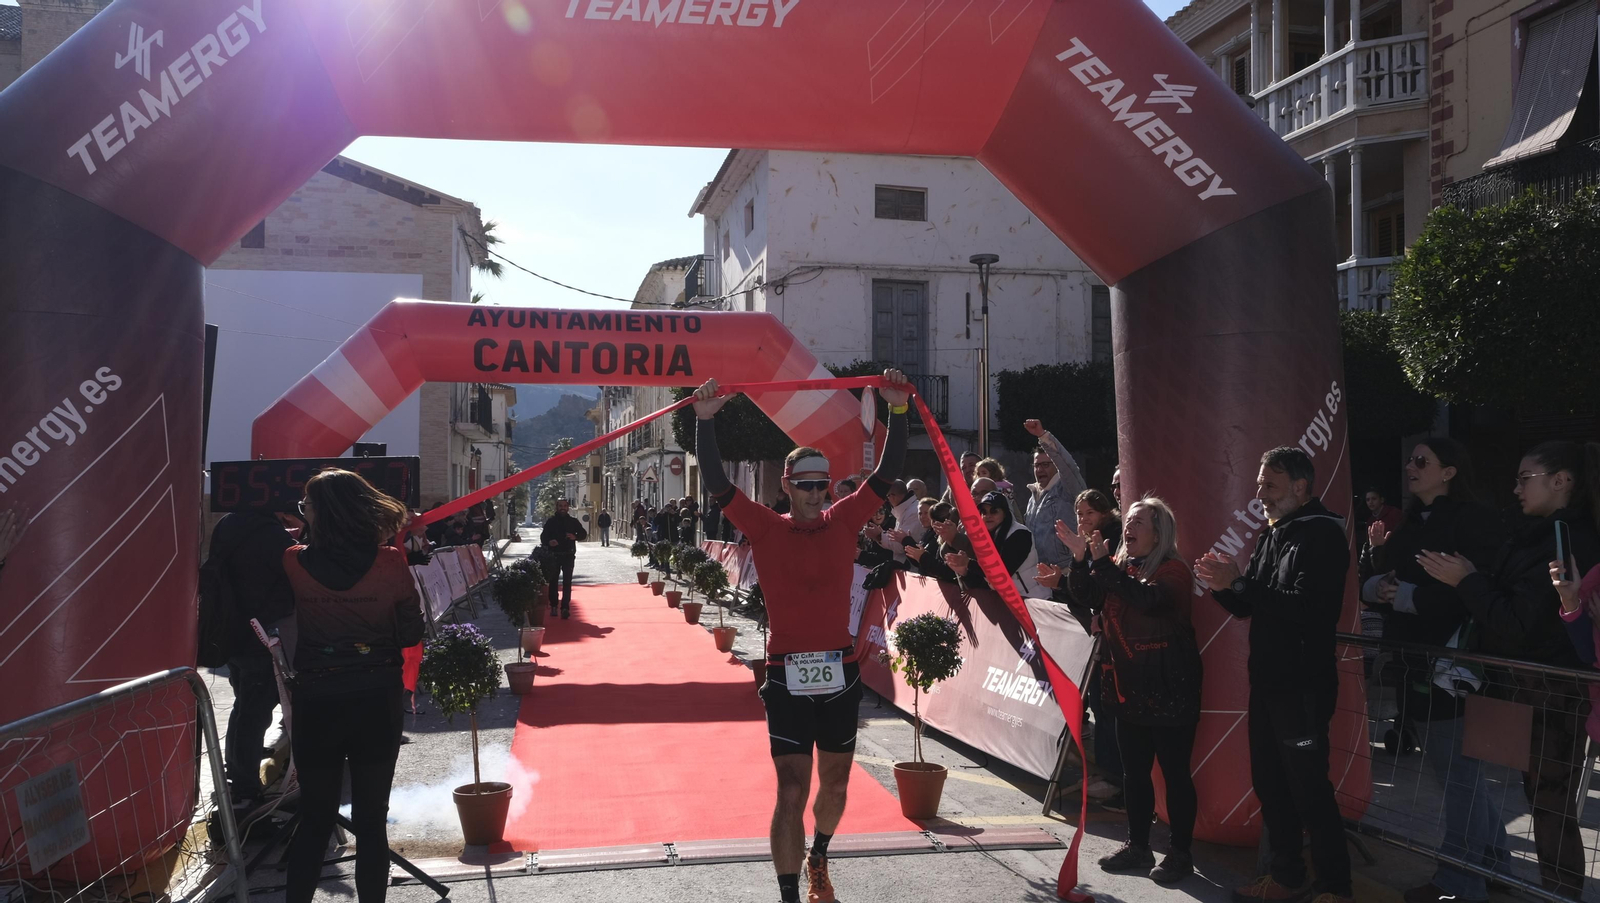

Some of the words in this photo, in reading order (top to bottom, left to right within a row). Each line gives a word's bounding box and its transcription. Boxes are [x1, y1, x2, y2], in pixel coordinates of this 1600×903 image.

[66, 0, 268, 176] TEAMERGY
[1055, 36, 1237, 201] TEAMERGY
[467, 308, 702, 334] AYUNTAMIENTO
[473, 338, 694, 377] CANTORIA
[798, 665, 833, 684] 326
[981, 665, 1054, 708] TEAMERGY
